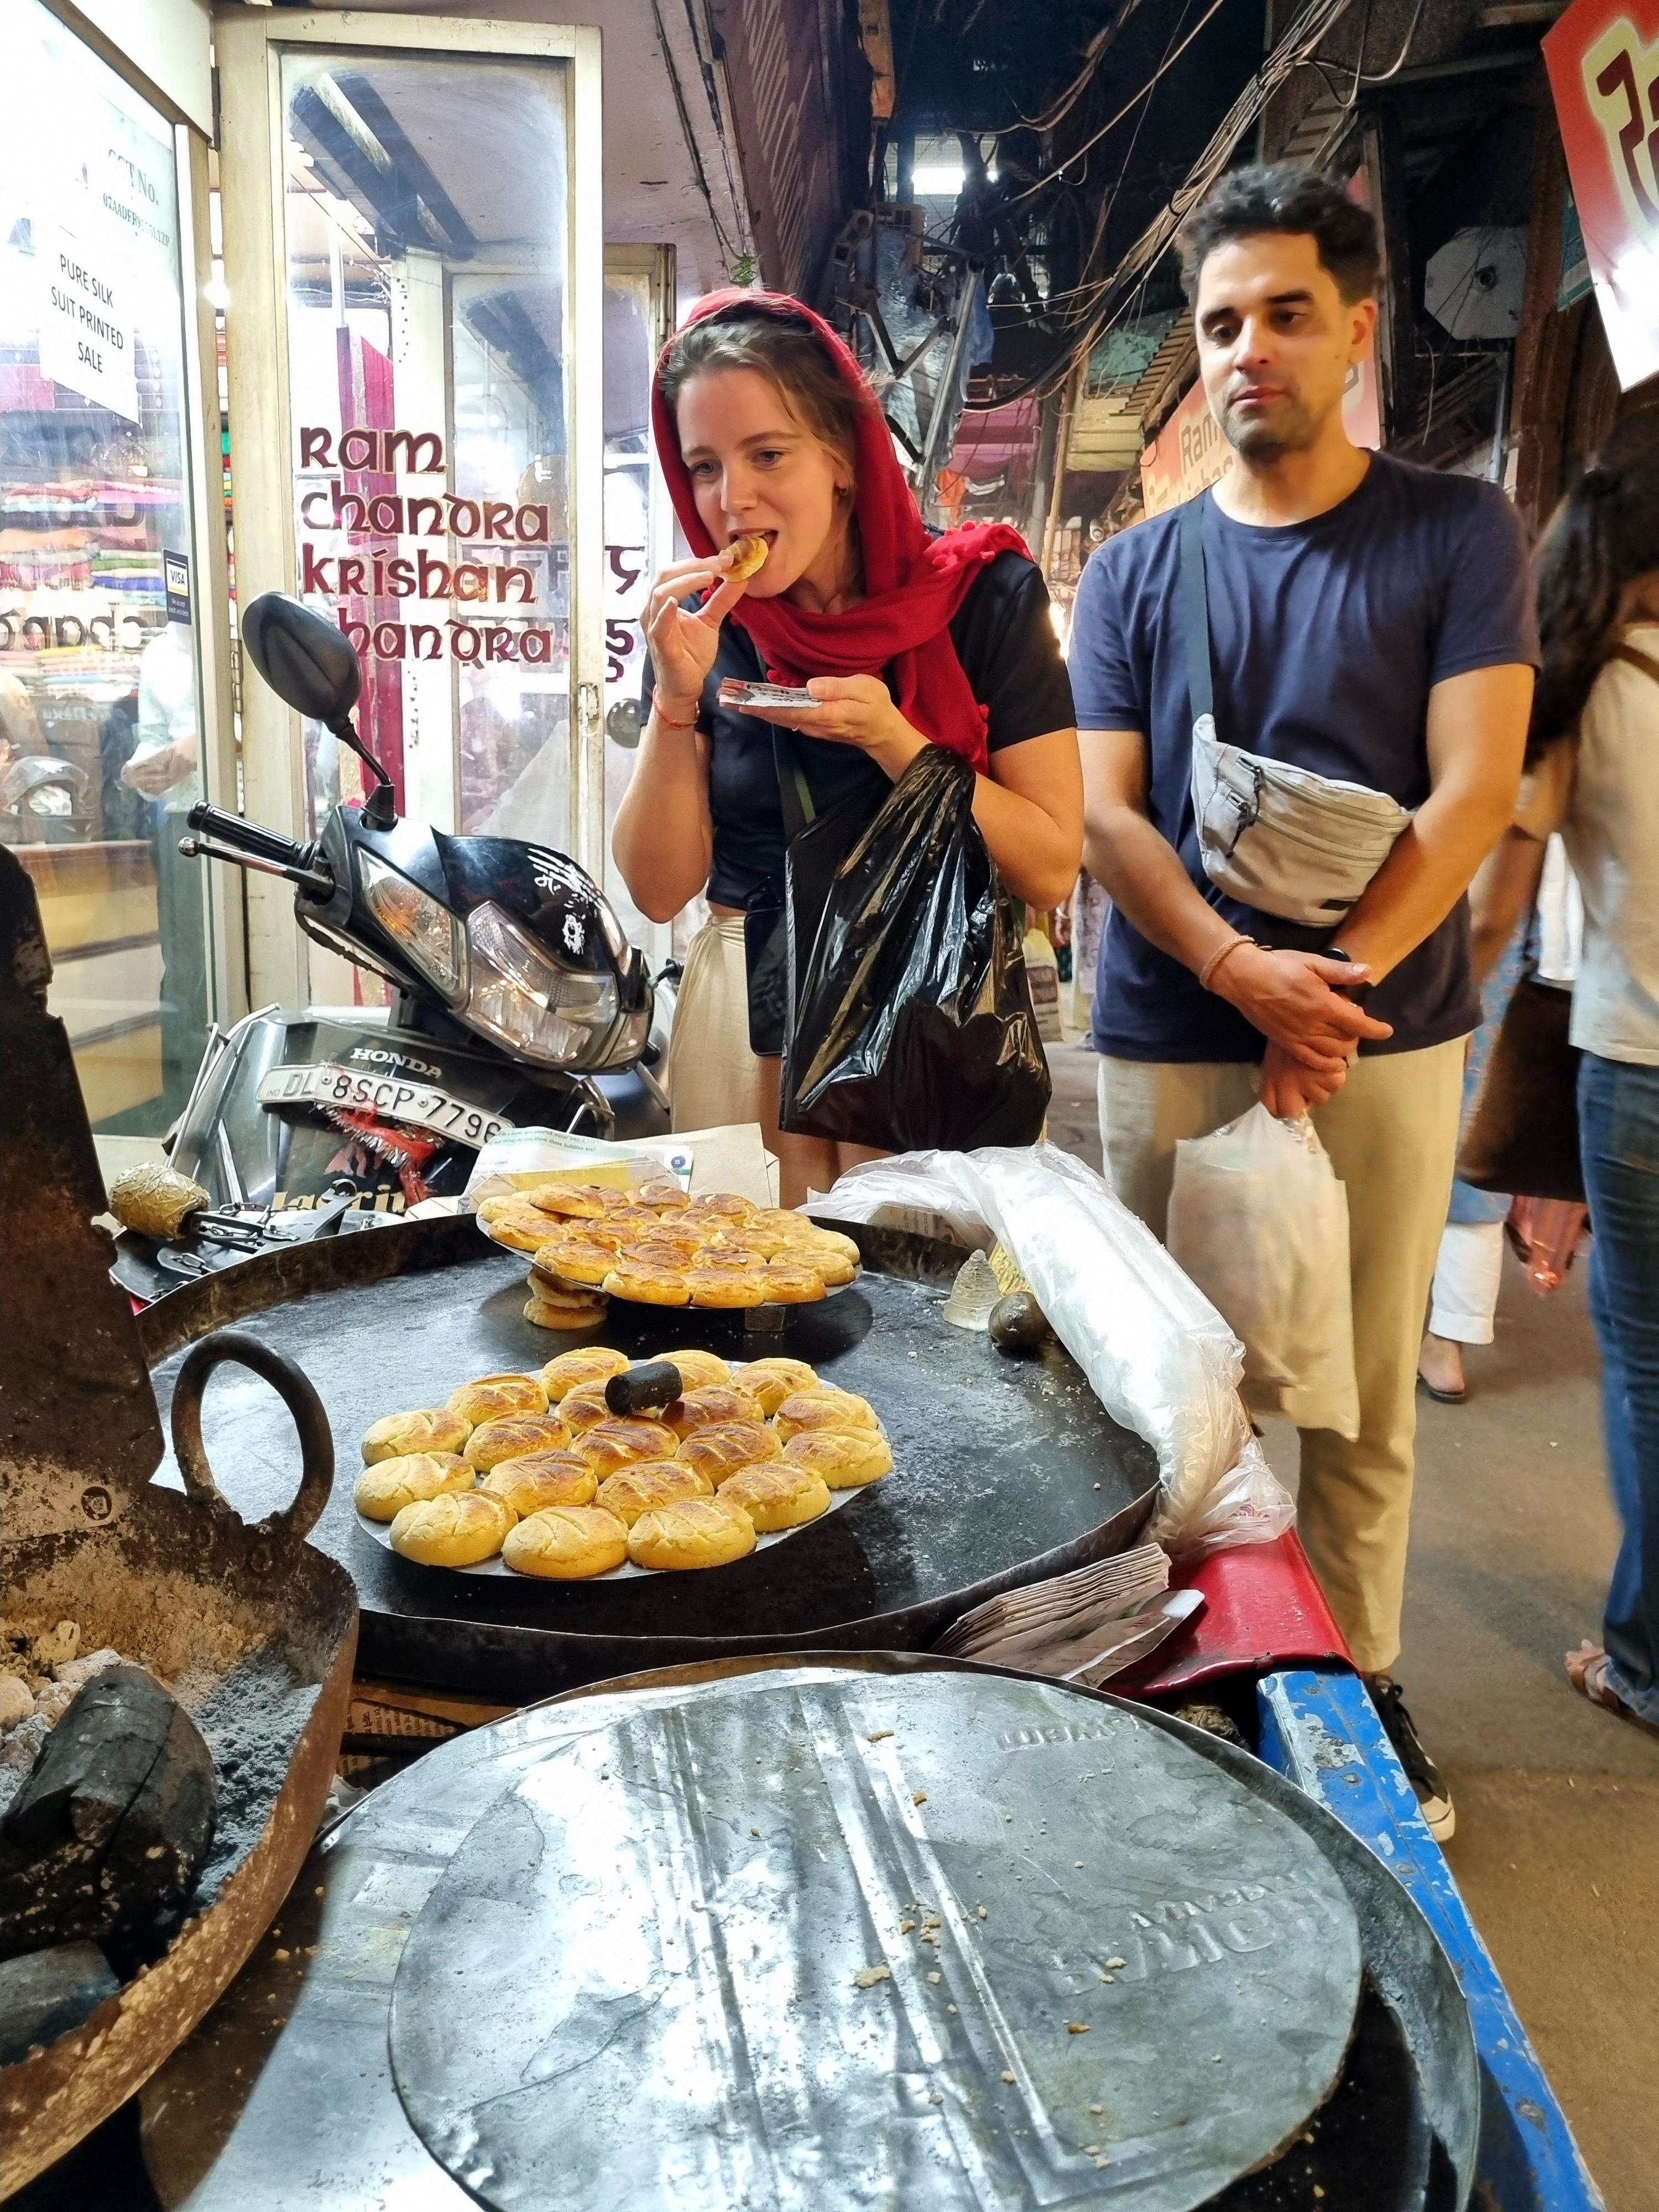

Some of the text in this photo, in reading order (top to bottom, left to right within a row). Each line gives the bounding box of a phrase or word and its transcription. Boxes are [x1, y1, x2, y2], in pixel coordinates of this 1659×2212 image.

[60, 253, 113, 309] PURE SILK
[51, 286, 124, 350] SUIT PRINTED
[78, 341, 103, 374] SALE
[169, 568, 185, 586] VISA
[337, 608, 553, 664] handra
[349, 1047, 442, 1079] HONDA
[283, 1071, 314, 1097] DL
